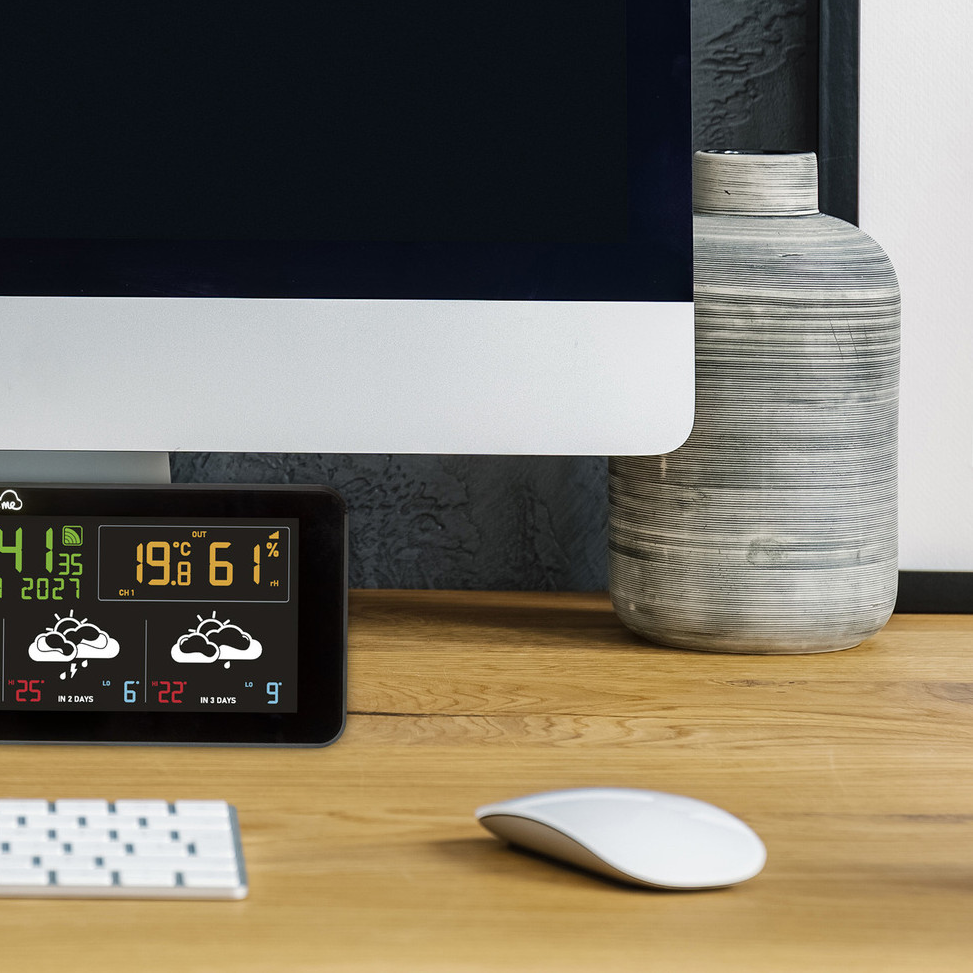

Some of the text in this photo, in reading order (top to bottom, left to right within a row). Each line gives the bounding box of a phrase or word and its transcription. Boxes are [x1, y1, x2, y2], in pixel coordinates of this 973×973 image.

[58, 553, 83, 576] 35
[209, 541, 261, 587] 61
[21, 577, 80, 600] 2027
[118, 589, 135, 597] CH 1
[57, 695, 94, 703] IN 2 DAYS
[200, 696, 237, 704] IN 3 DAYS
